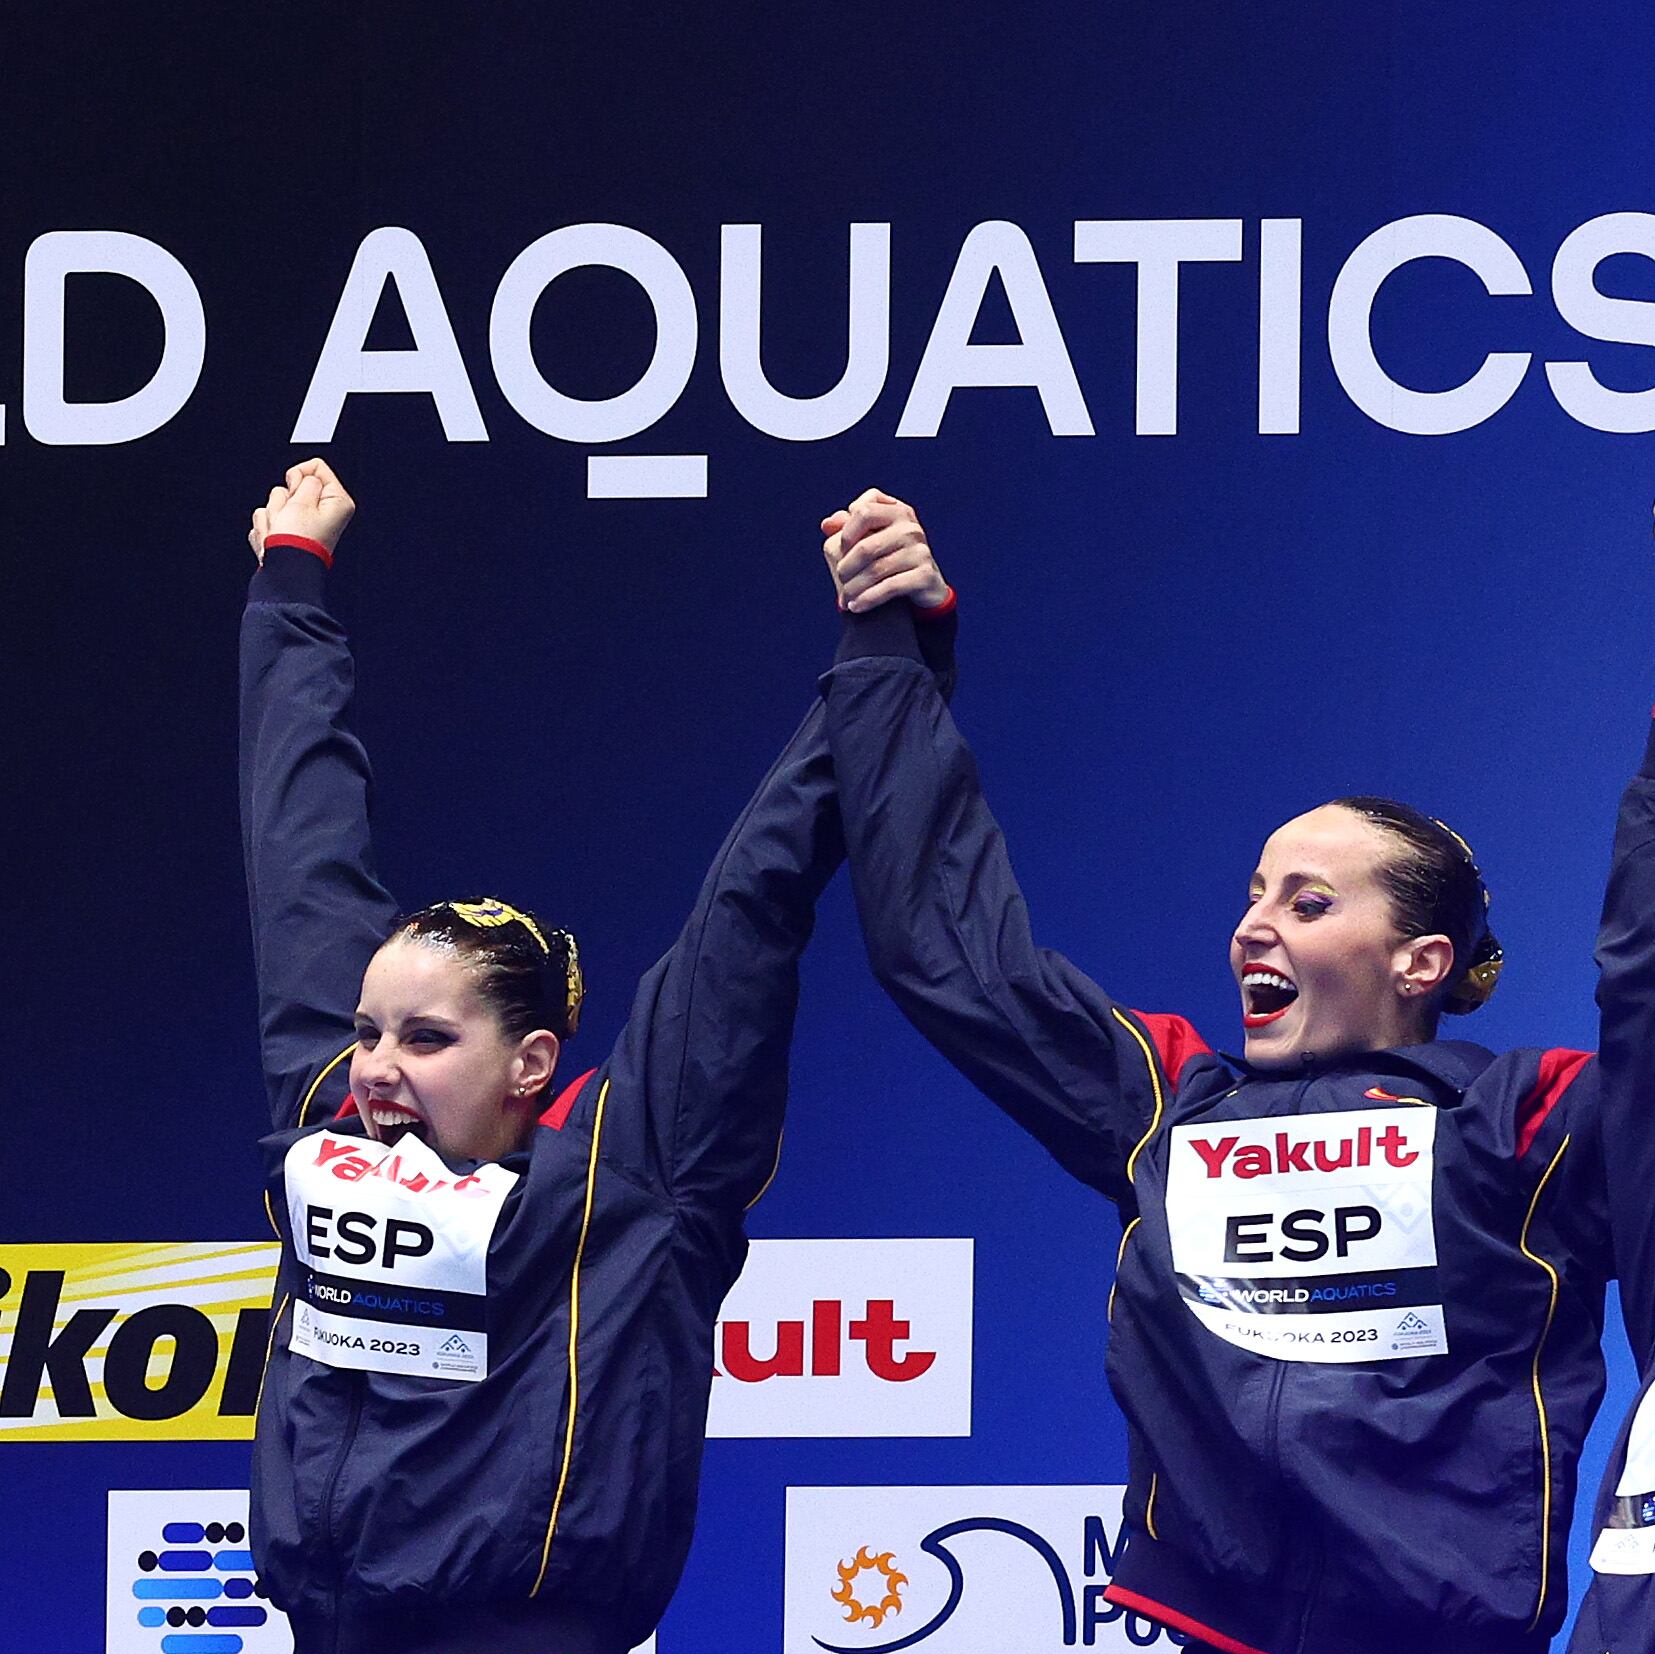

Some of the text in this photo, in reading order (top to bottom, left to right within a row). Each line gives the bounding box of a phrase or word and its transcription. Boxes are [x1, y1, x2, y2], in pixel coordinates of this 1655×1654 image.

[0, 230, 208, 446] D
[1188, 1125, 1420, 1179] Yakult
[306, 1204, 435, 1269] ESP
[1223, 1205, 1382, 1263] ESP
[352, 1292, 446, 1317] AQUATICS
[1310, 1282, 1397, 1301] AQUATICS
[370, 1338, 421, 1357] 2023
[711, 1300, 936, 1382] ult
[1330, 1329, 1379, 1343] 2023
